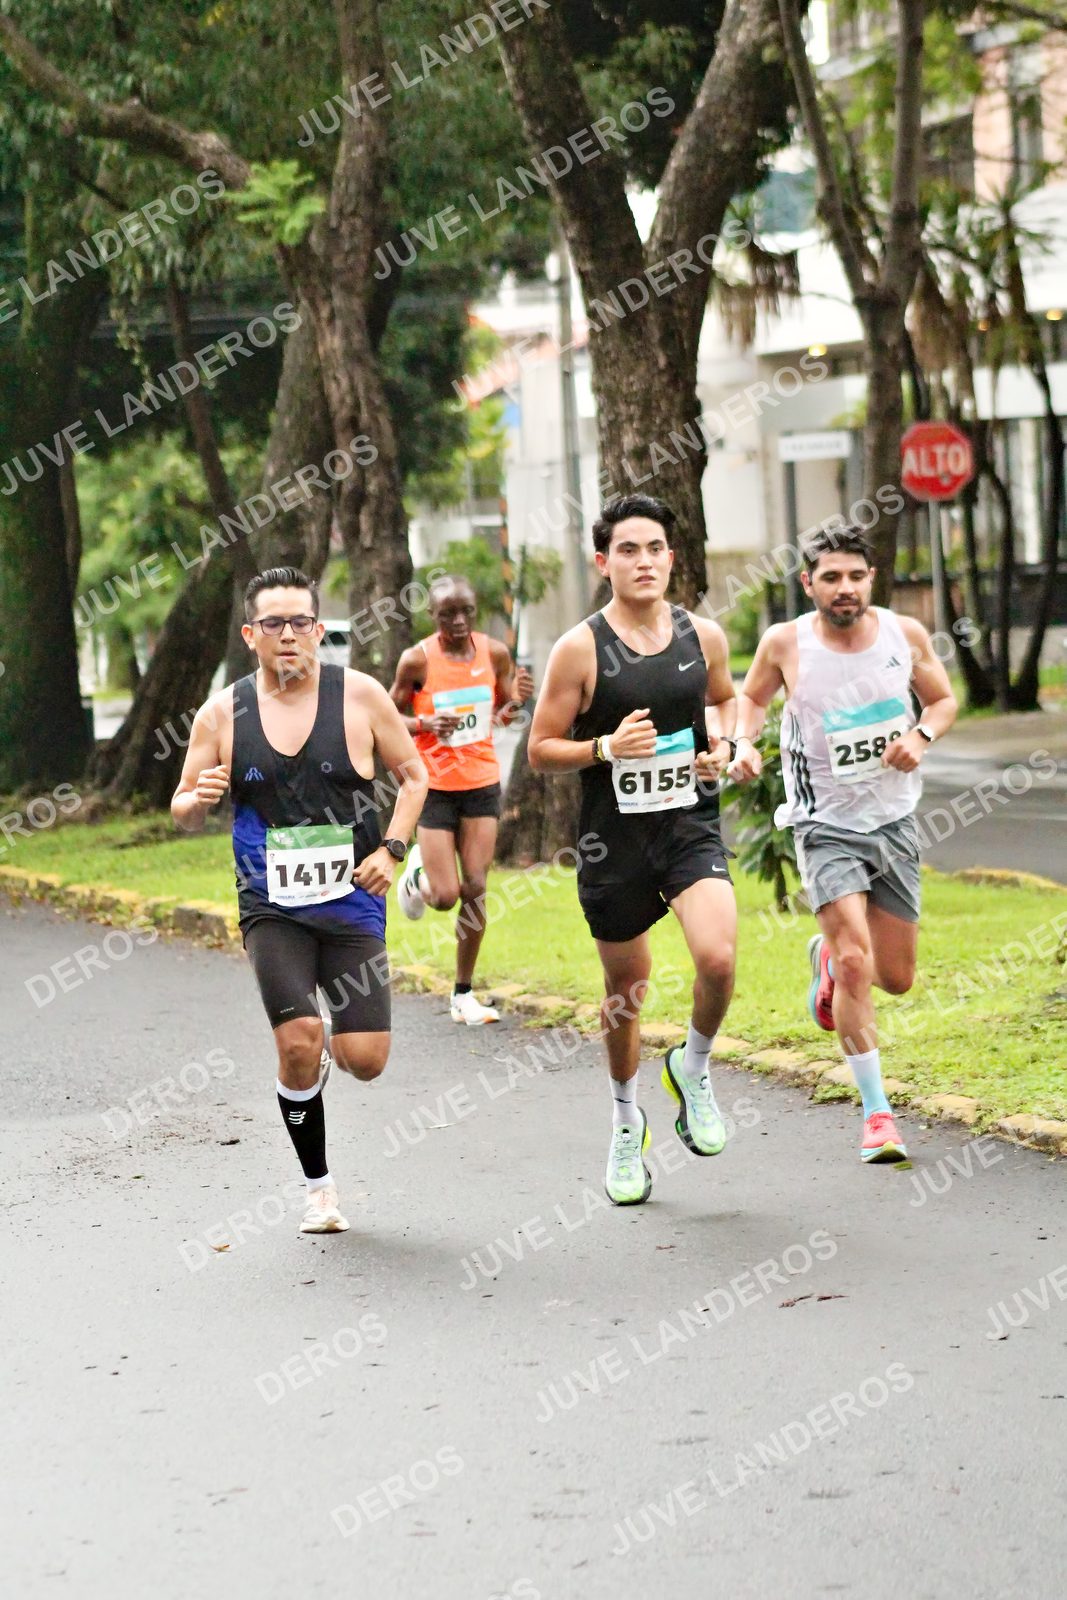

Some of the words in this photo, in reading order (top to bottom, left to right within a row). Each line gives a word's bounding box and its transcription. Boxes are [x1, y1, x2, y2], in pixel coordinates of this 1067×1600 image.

[901, 443, 971, 479] ALTO
[619, 765, 691, 795] 6155
[275, 859, 349, 888] 1417
